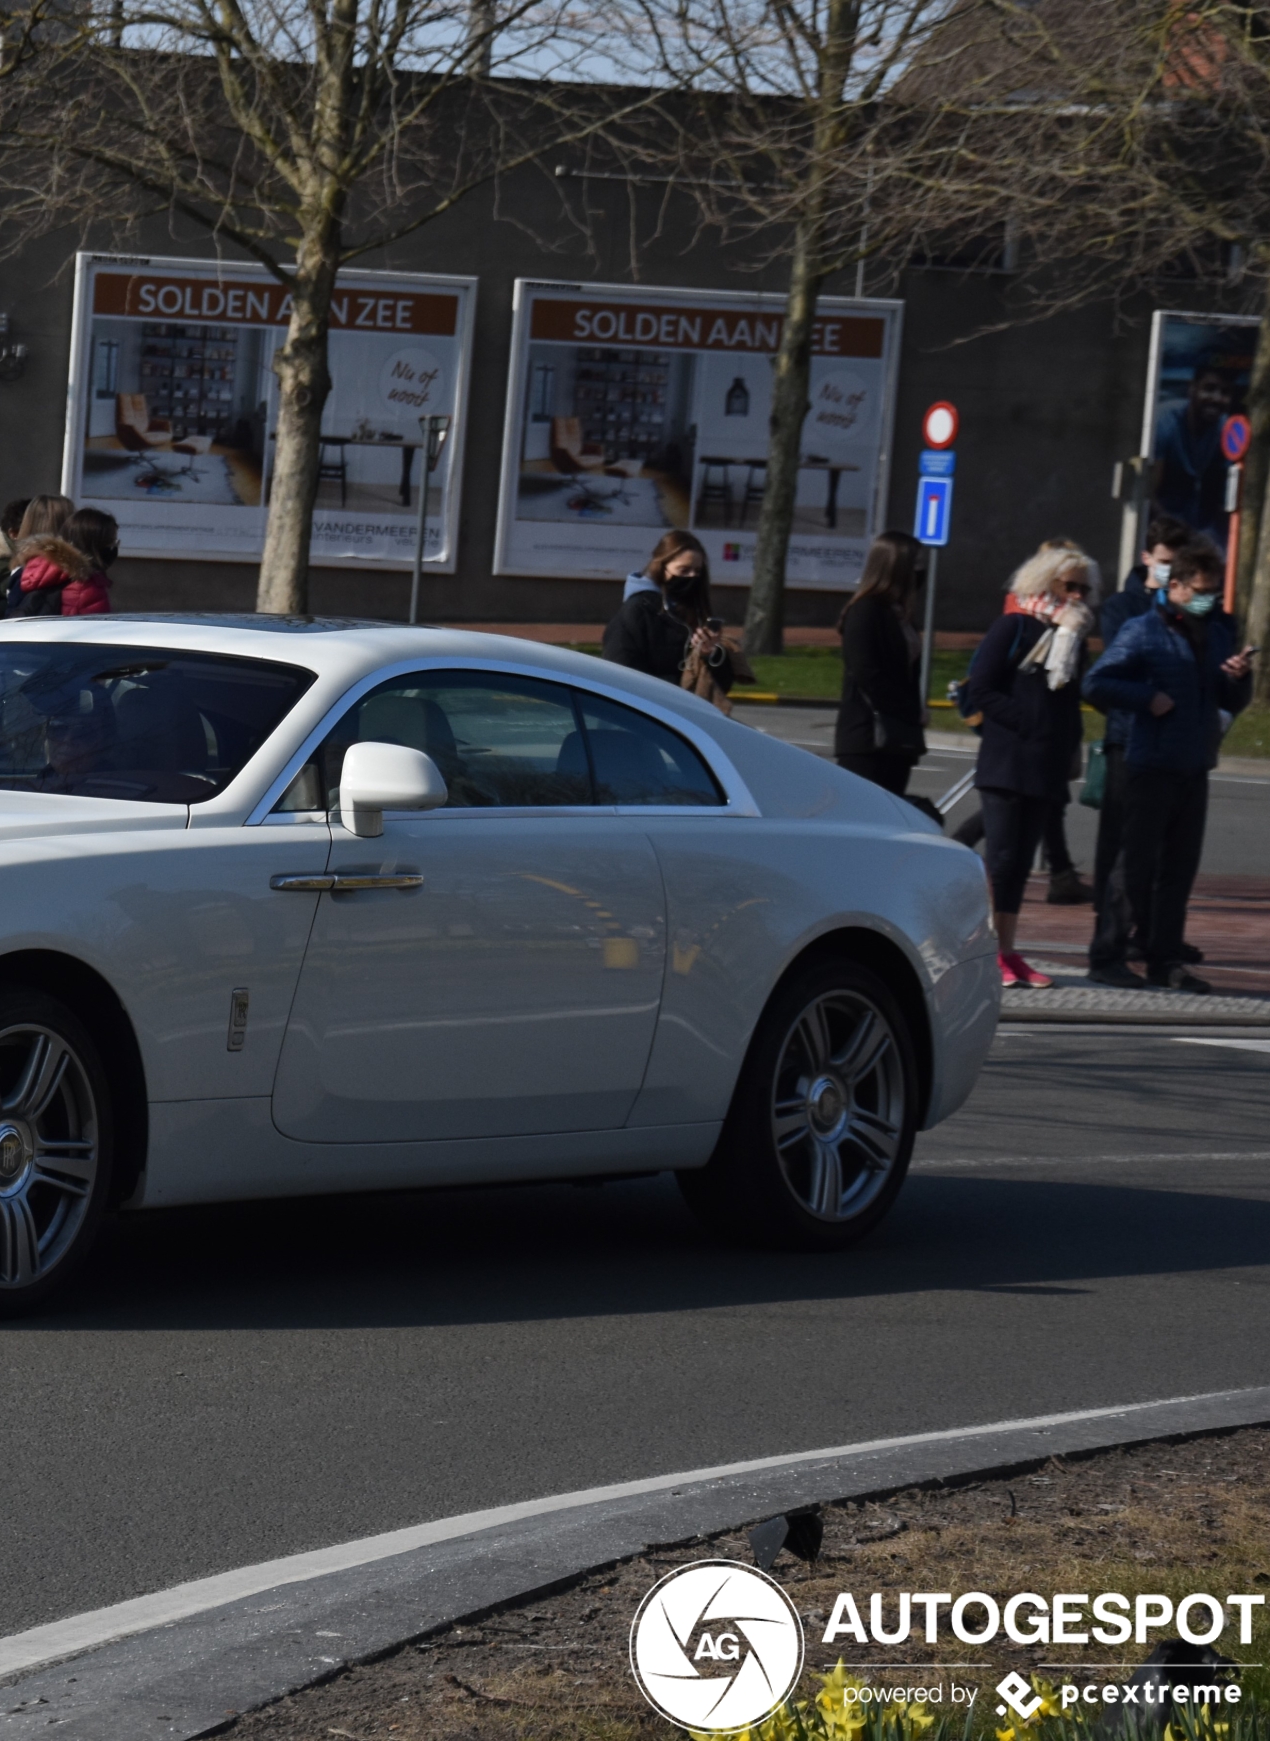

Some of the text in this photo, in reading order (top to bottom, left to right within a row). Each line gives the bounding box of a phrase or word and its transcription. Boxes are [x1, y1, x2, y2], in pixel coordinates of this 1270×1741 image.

[138, 283, 414, 329] SOLDEN AN ZEE
[573, 308, 702, 345] SOLDEN
[705, 317, 779, 349] AAN
[390, 360, 439, 392] Nu of
